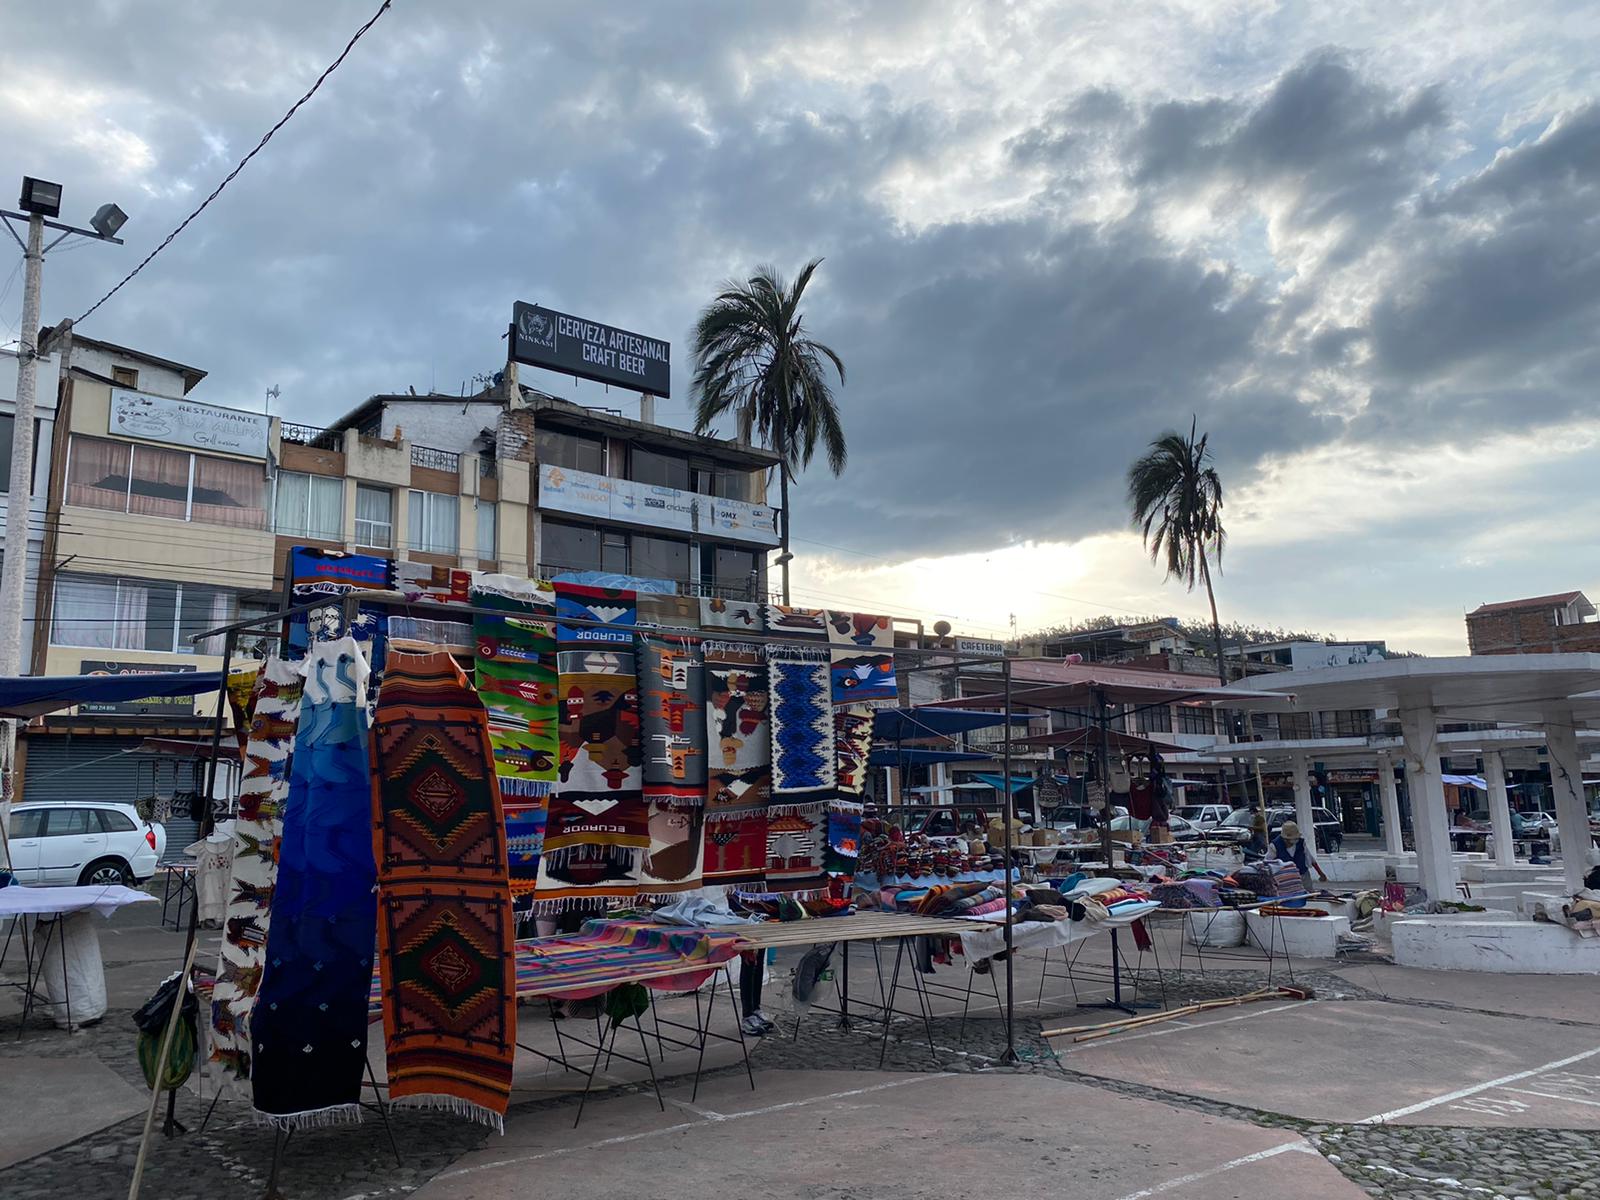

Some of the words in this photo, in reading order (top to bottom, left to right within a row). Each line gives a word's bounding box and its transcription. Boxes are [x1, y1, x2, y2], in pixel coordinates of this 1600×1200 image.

[518, 332, 553, 348] NINKASI
[558, 316, 606, 346] CERVEZA
[609, 331, 668, 363] ARTESANAL
[582, 343, 617, 368] CRAFT
[619, 353, 646, 376] BEER
[178, 405, 259, 424] RESTAURANTE
[576, 631, 633, 642] ECUADOR
[961, 641, 1003, 651] CAFETERIA
[562, 824, 626, 833] ECUADOR
